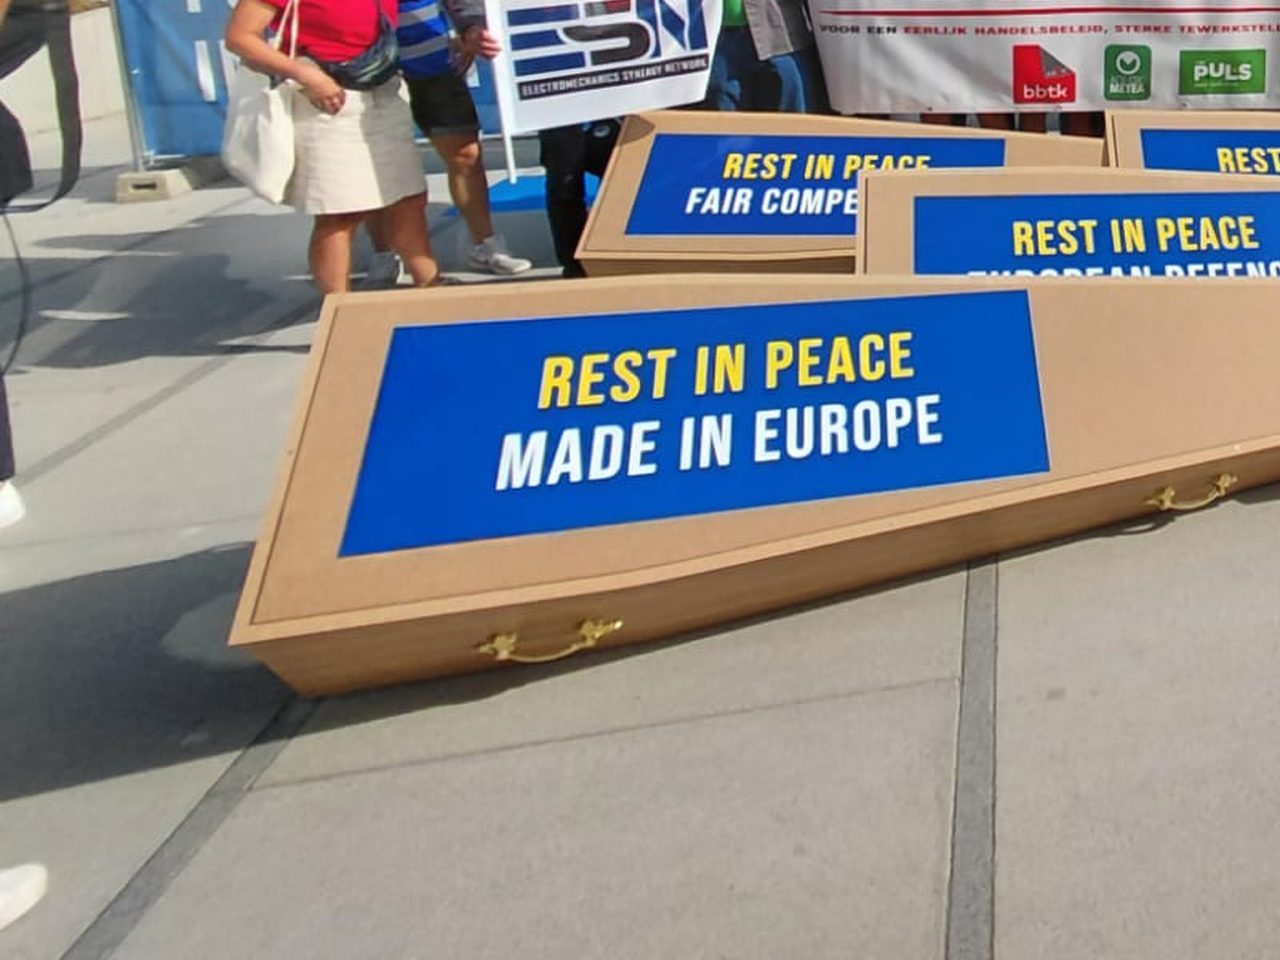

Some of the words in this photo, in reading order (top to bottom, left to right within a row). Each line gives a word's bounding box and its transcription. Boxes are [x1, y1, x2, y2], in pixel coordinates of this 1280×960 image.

[819, 24, 860, 35] VOOR
[866, 24, 897, 35] EEN
[903, 24, 967, 36] EERLIJK
[974, 24, 1109, 37] HANDELSBELEID,
[1114, 24, 1172, 35] STERKE
[1193, 62, 1252, 81] PULS
[1023, 84, 1068, 100] bbtk
[722, 153, 798, 180] REST
[803, 154, 834, 180] IN
[684, 188, 753, 215] FAIR
[1012, 219, 1098, 256] REST
[1110, 218, 1146, 253] IN
[1156, 215, 1260, 252] PEACE
[538, 348, 677, 410] REST
[694, 343, 746, 395] IN
[765, 331, 915, 389] PEACE
[494, 421, 661, 491] MADE
[679, 414, 733, 470] IN
[753, 394, 943, 463] EUROPE
